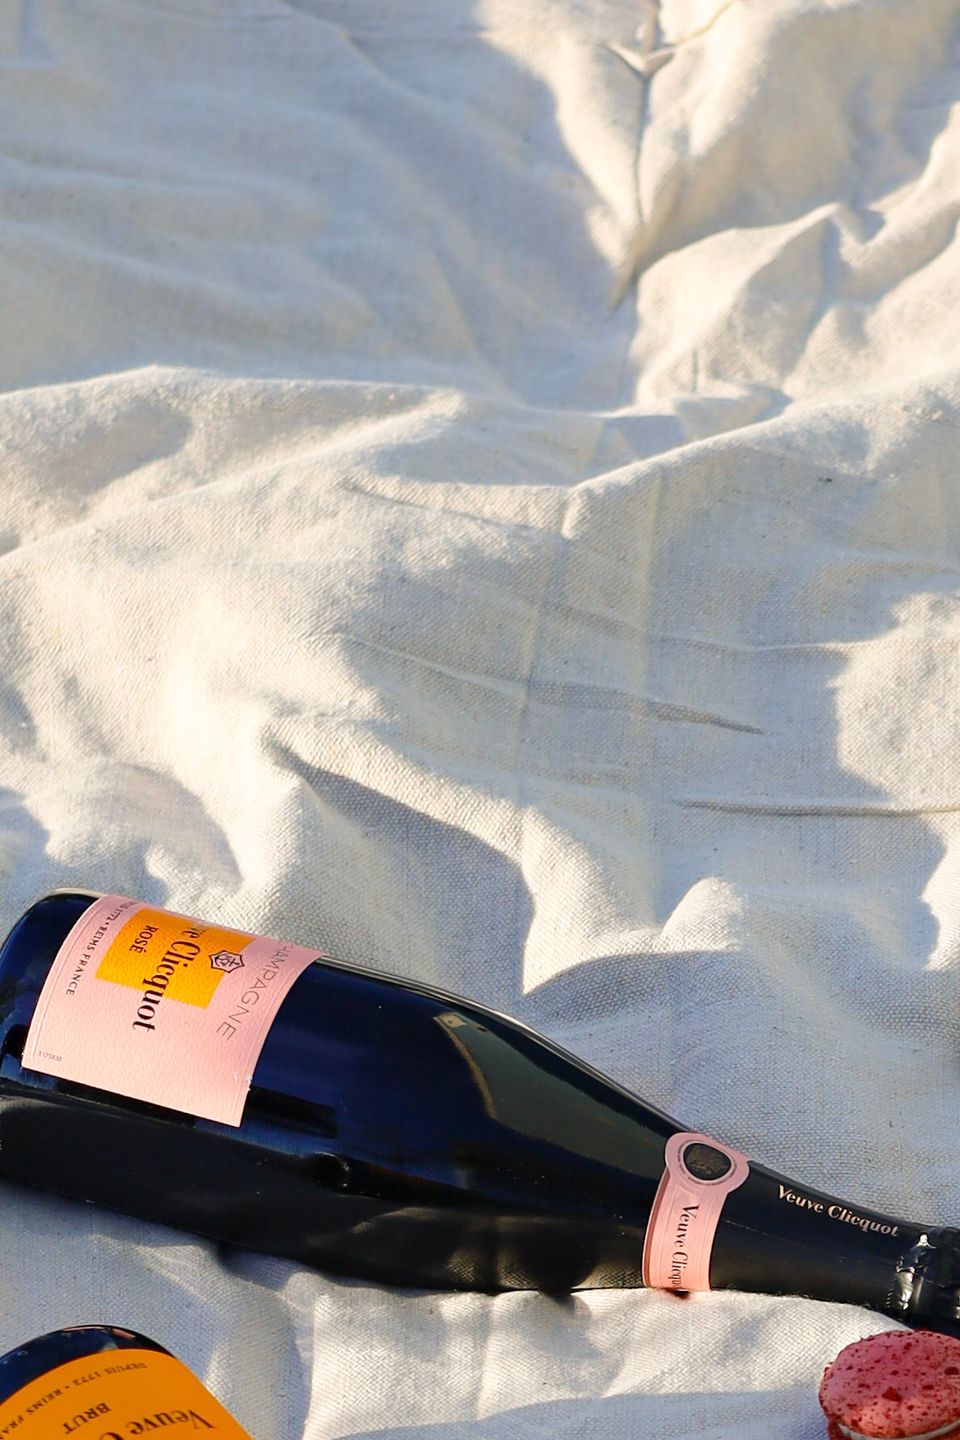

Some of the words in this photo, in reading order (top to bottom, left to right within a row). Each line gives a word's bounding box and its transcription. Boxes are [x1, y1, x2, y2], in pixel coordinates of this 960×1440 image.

[87, 925, 108, 952] REIMS
[129, 925, 159, 954] ROSÉ
[66, 953, 92, 997] FRANCE
[131, 940, 201, 1033] Clicquot
[674, 1203, 701, 1248] Veuve
[778, 1184, 824, 1214] Veuve
[827, 1204, 899, 1237] Clicquot
[26, 1388, 63, 1415] REIMS
[62, 1402, 112, 1435] BRUT
[125, 1409, 217, 1436] Veuve
